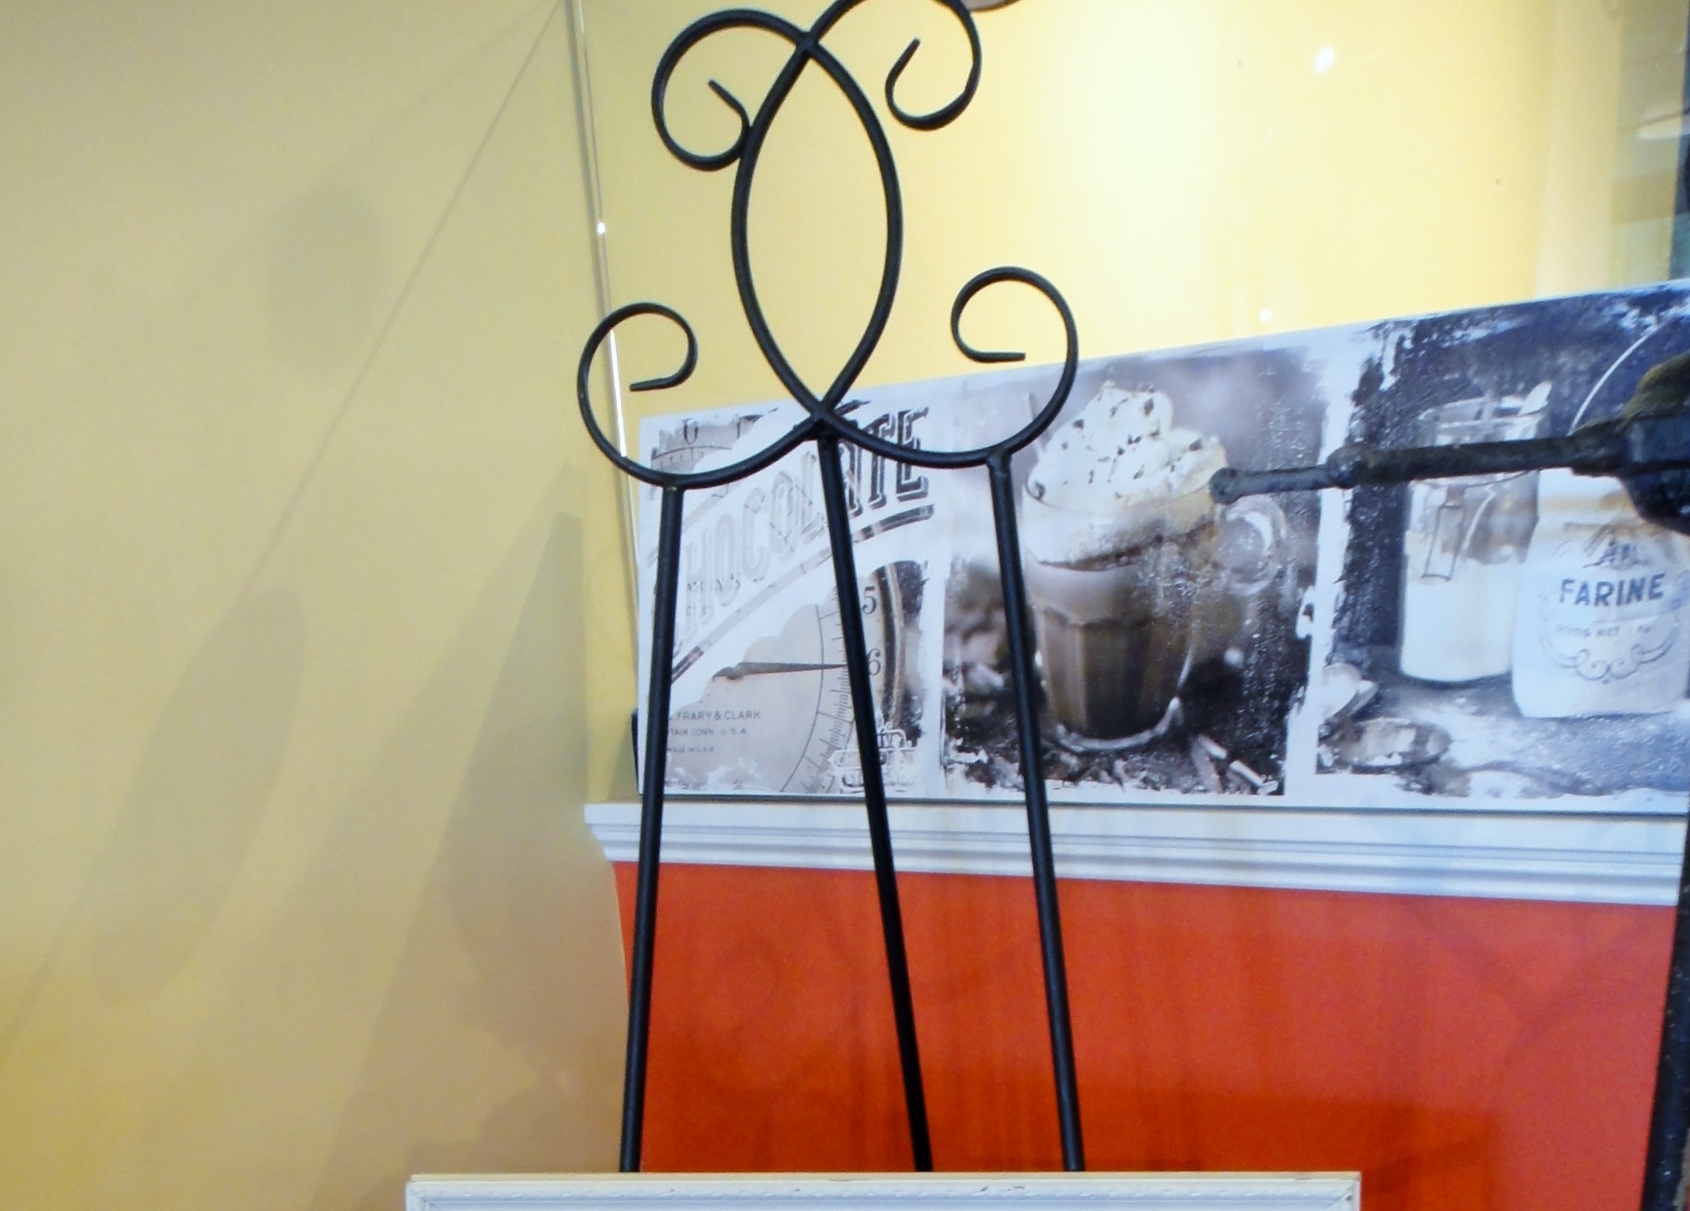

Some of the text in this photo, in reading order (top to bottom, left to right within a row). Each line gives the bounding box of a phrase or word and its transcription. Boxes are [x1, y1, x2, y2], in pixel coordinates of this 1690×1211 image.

[862, 586, 877, 615] 5
[1559, 573, 1666, 607] FARINE
[866, 648, 881, 676] 6
[714, 710, 721, 720] &
[724, 710, 762, 720] CLARK
